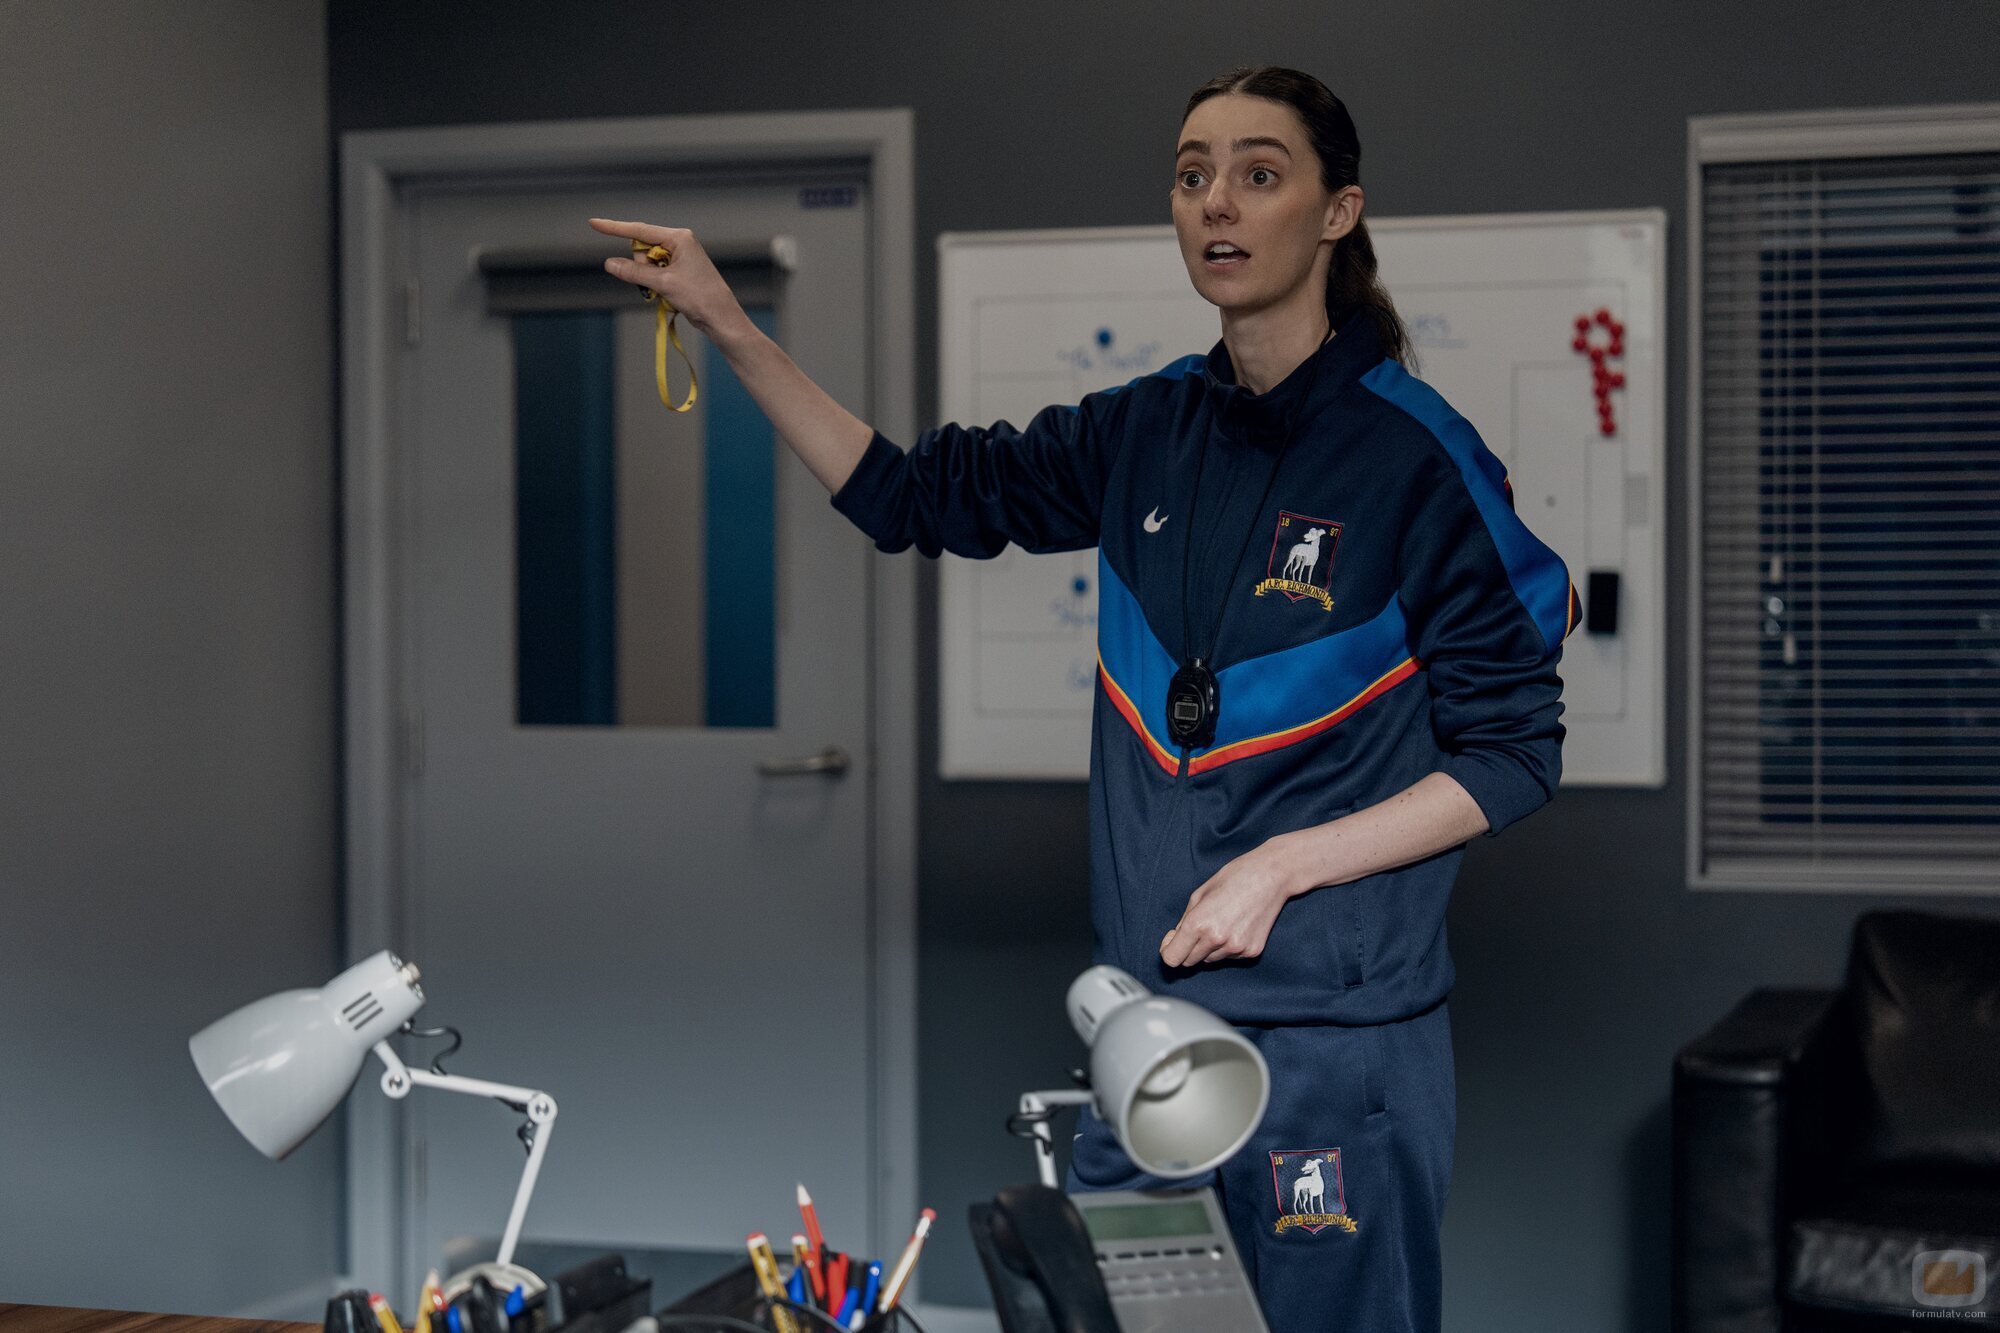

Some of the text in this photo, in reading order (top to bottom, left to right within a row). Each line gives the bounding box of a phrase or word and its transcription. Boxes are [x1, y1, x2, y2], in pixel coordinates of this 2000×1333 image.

[1281, 518, 1339, 537] 18 97
[1288, 581, 1327, 598] RICHMOND
[1274, 1156, 1284, 1165] 18
